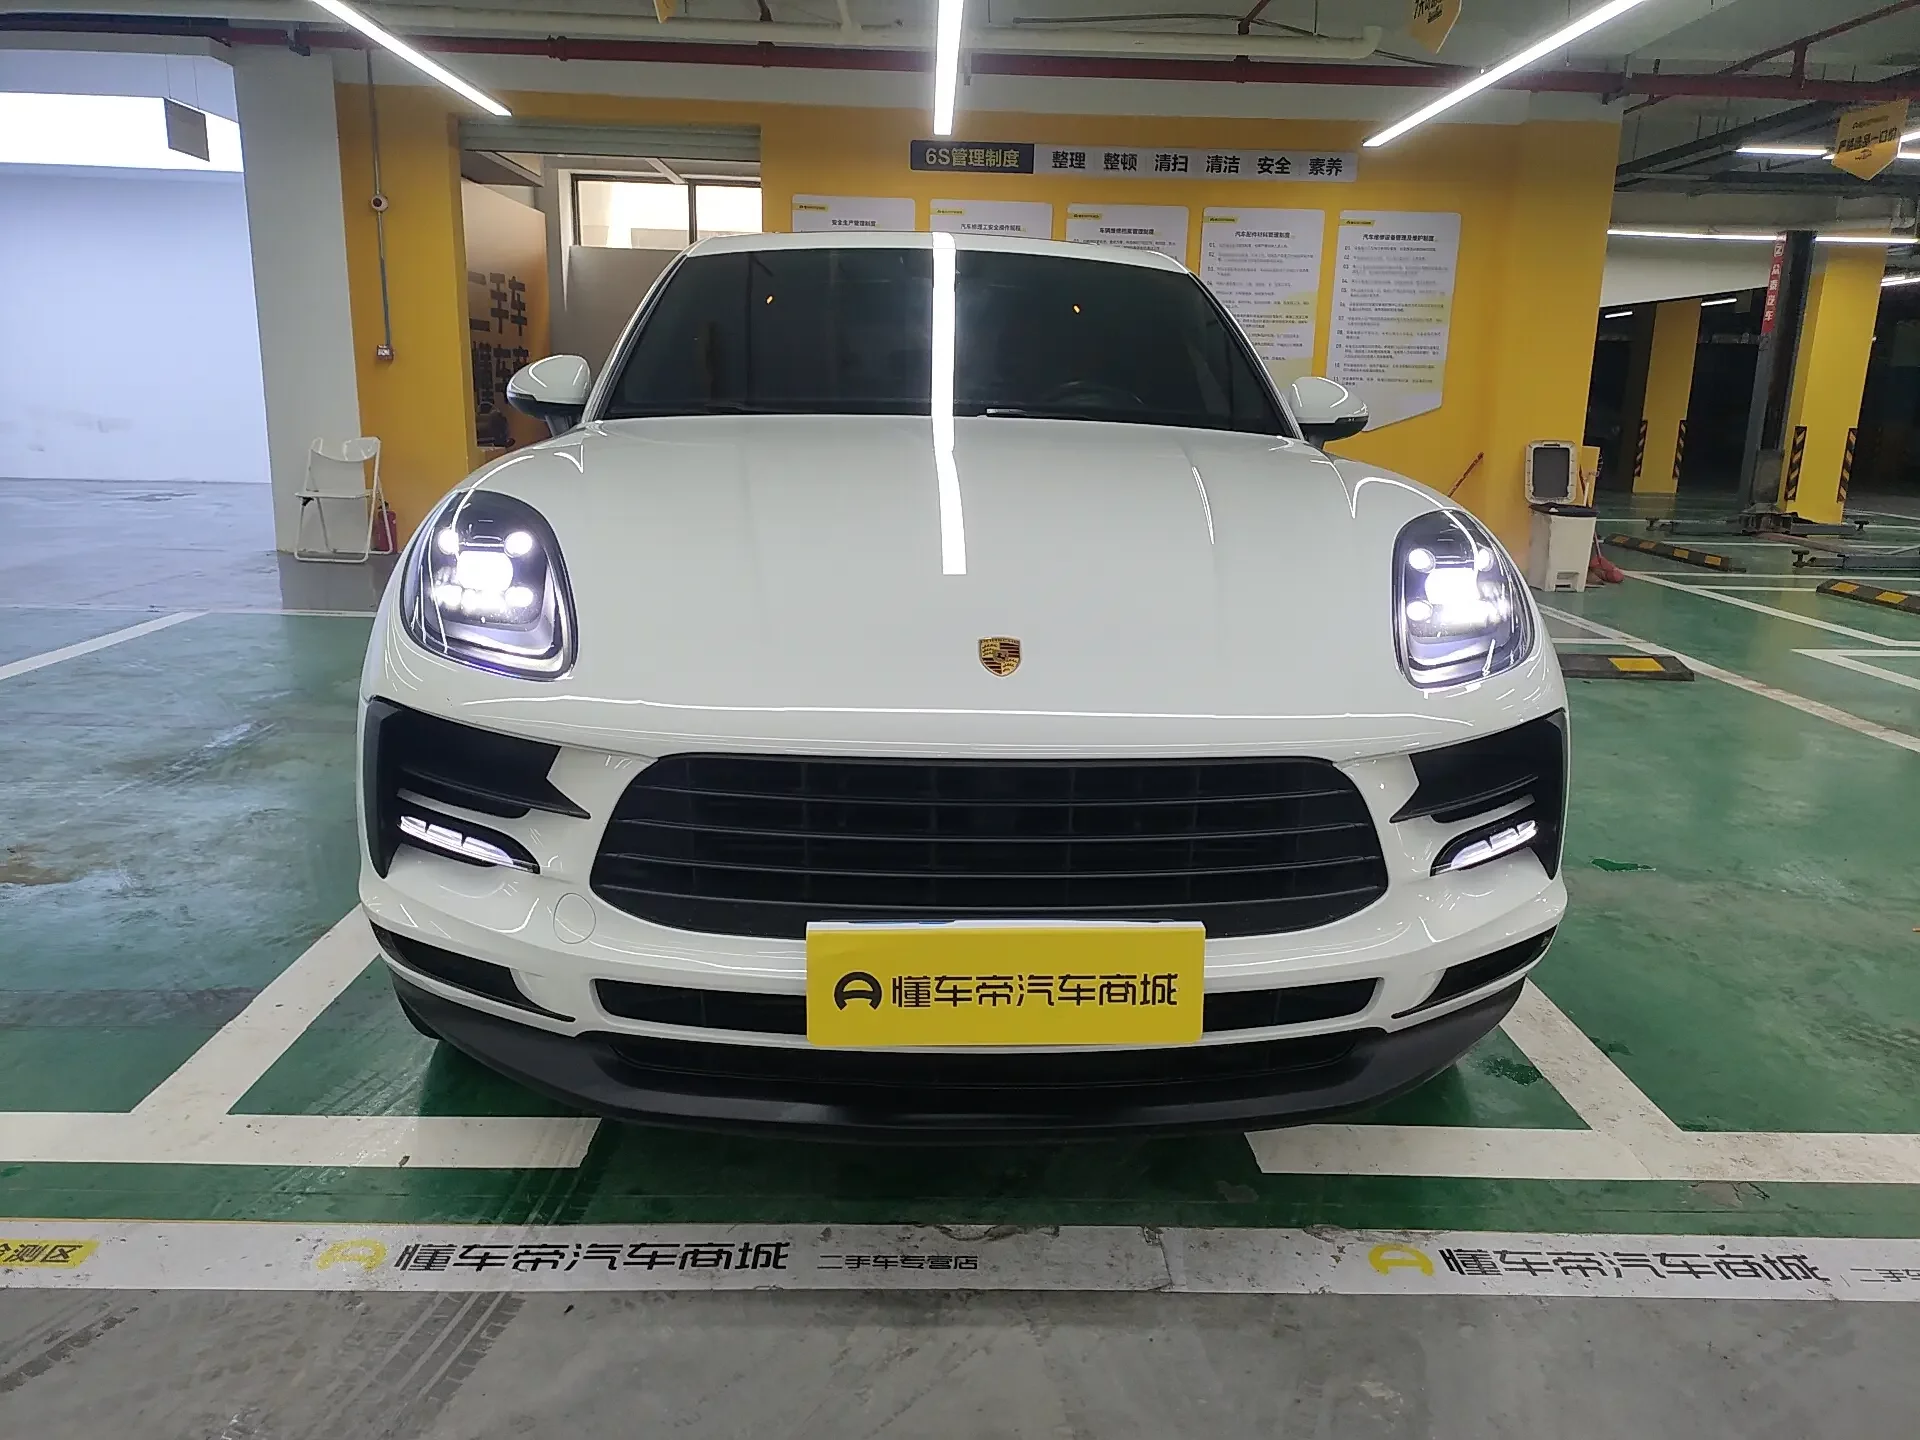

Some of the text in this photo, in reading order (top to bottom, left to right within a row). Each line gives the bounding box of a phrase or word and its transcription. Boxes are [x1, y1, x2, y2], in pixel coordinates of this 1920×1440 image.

[925, 148, 1020, 168] 6S管理制度
[1052, 151, 1343, 176] 整理 整顿 清扫 清洁 安全 素养
[831, 219, 877, 227] 安全生产管理制度
[960, 223, 1022, 232] 汽车修理工安全操作规程
[1234, 231, 1291, 239] 汽车配件材料管理制度
[1362, 234, 1435, 242] 汽车维修设备管理及维护制度
[891, 973, 1180, 1008] 懂车帝汽车商城
[394, 1242, 979, 1272] 懂车帝汽车商城 二手车专营店
[1439, 1247, 1830, 1281] 懂车帝汽车商城
